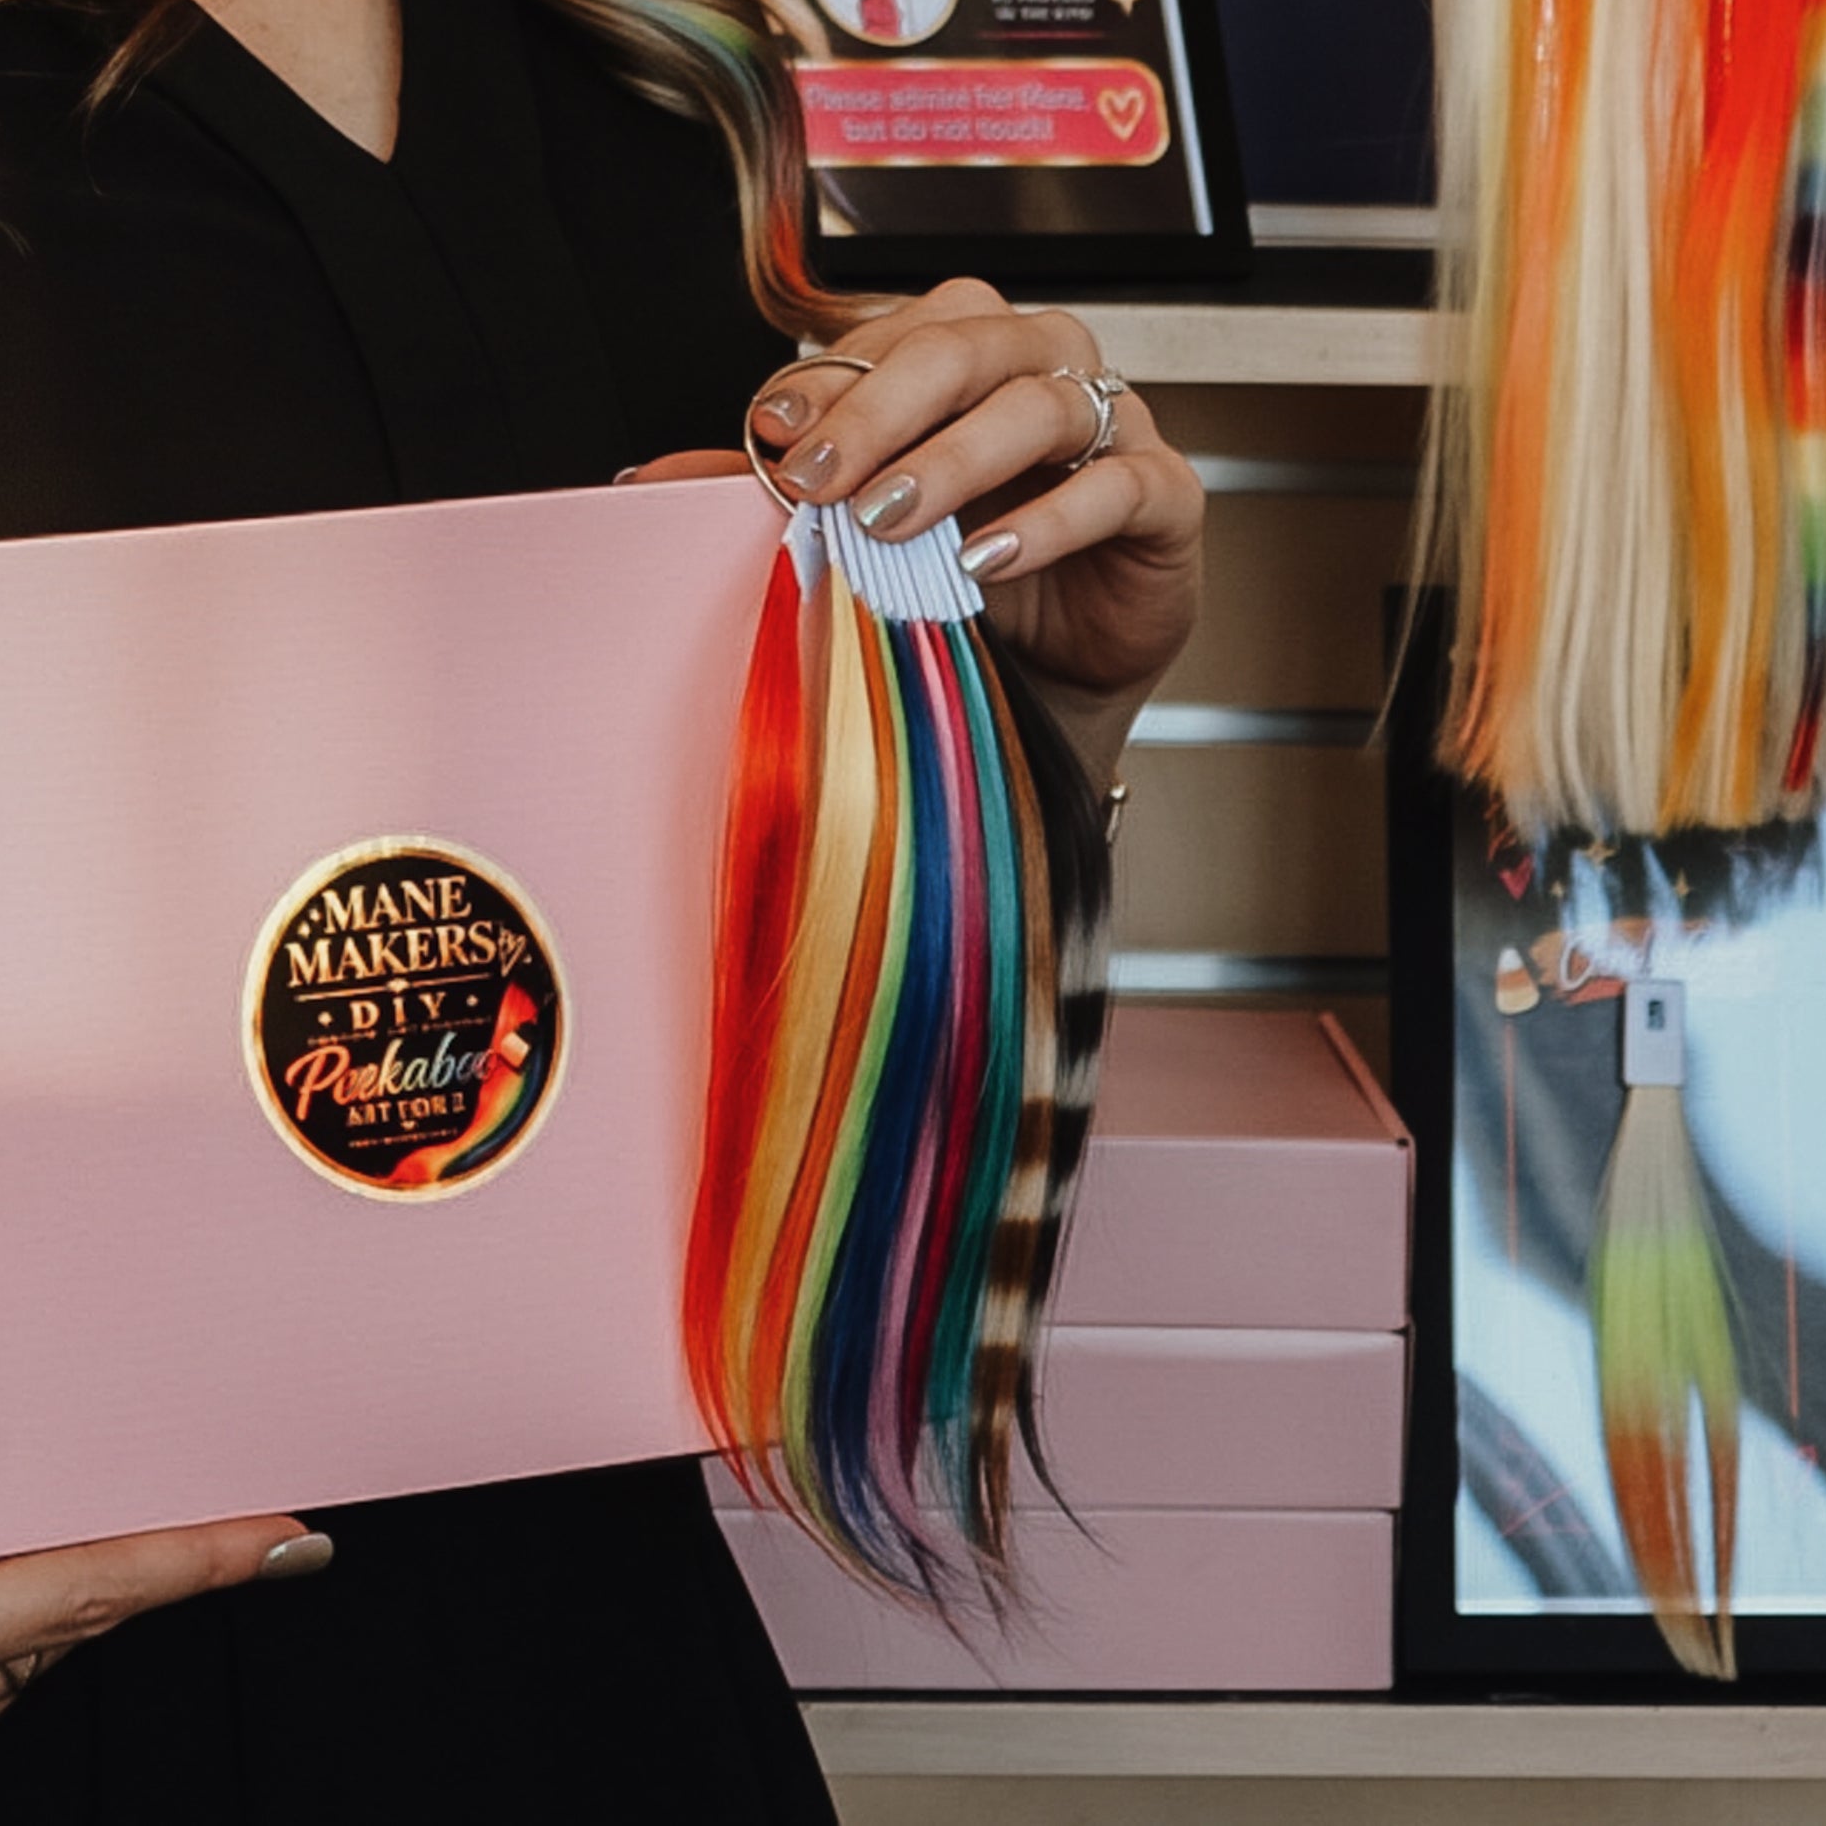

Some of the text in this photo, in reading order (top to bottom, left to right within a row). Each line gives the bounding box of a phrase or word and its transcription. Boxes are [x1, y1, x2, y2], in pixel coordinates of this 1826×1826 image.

[321, 874, 473, 935] MANE
[285, 919, 499, 988] MAKERS
[349, 990, 447, 1031] DIY
